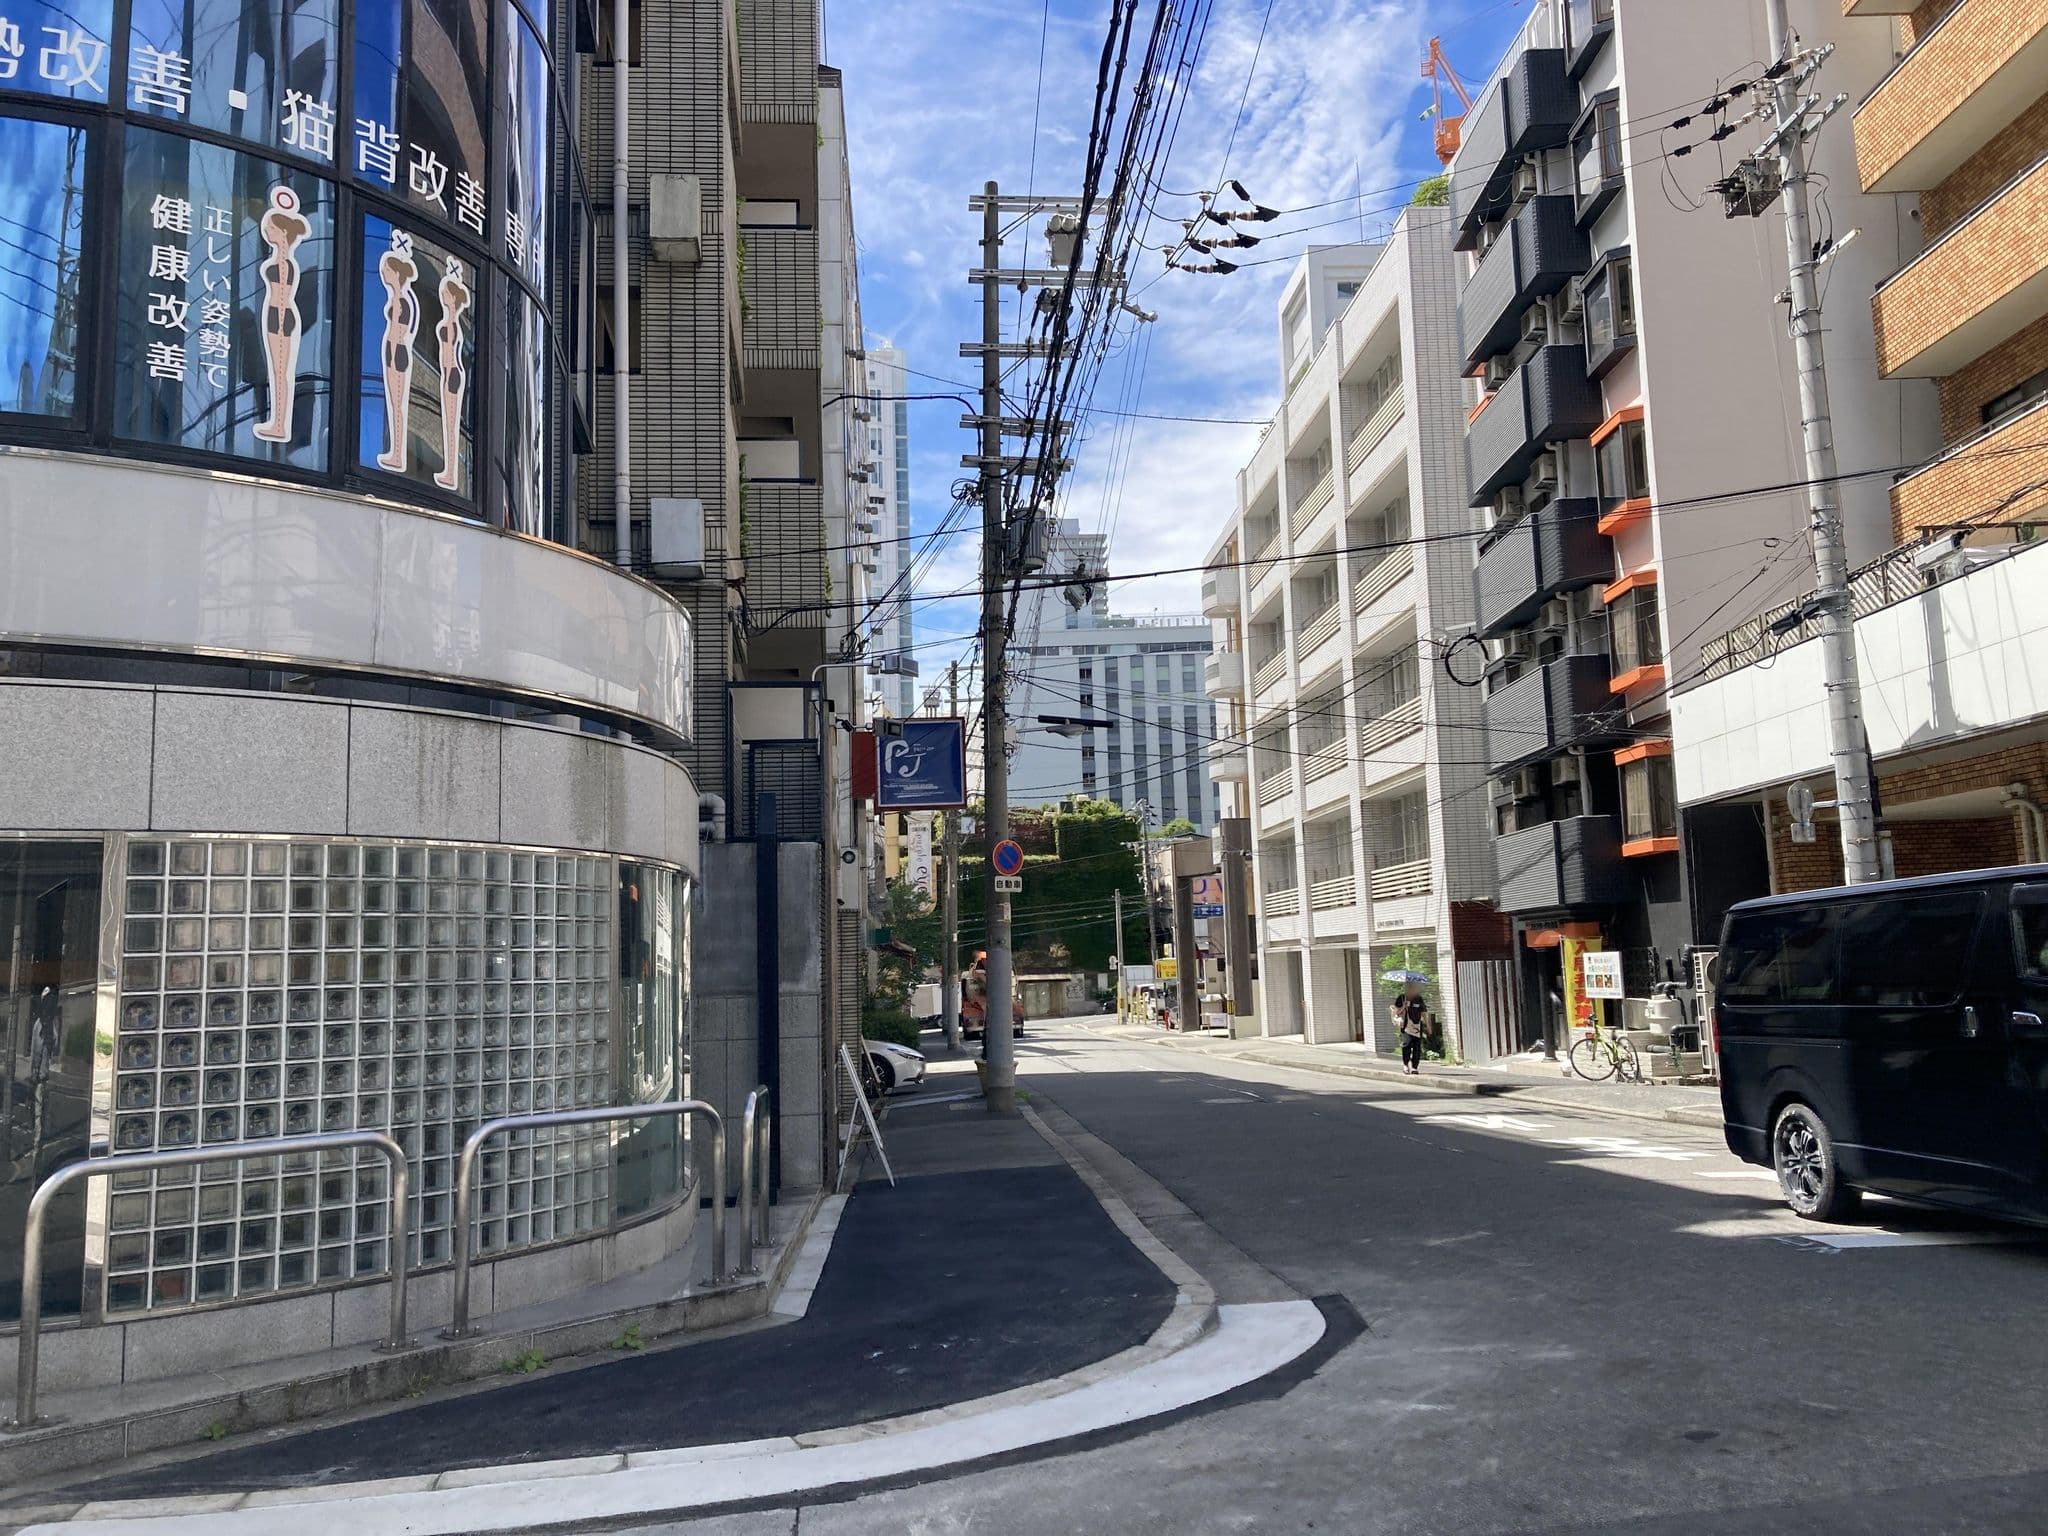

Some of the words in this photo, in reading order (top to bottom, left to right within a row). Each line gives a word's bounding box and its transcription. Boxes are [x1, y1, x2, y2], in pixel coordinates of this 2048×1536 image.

[146, 194, 193, 382] 健康改善
[200, 204, 233, 389] 正しい姿勢で
